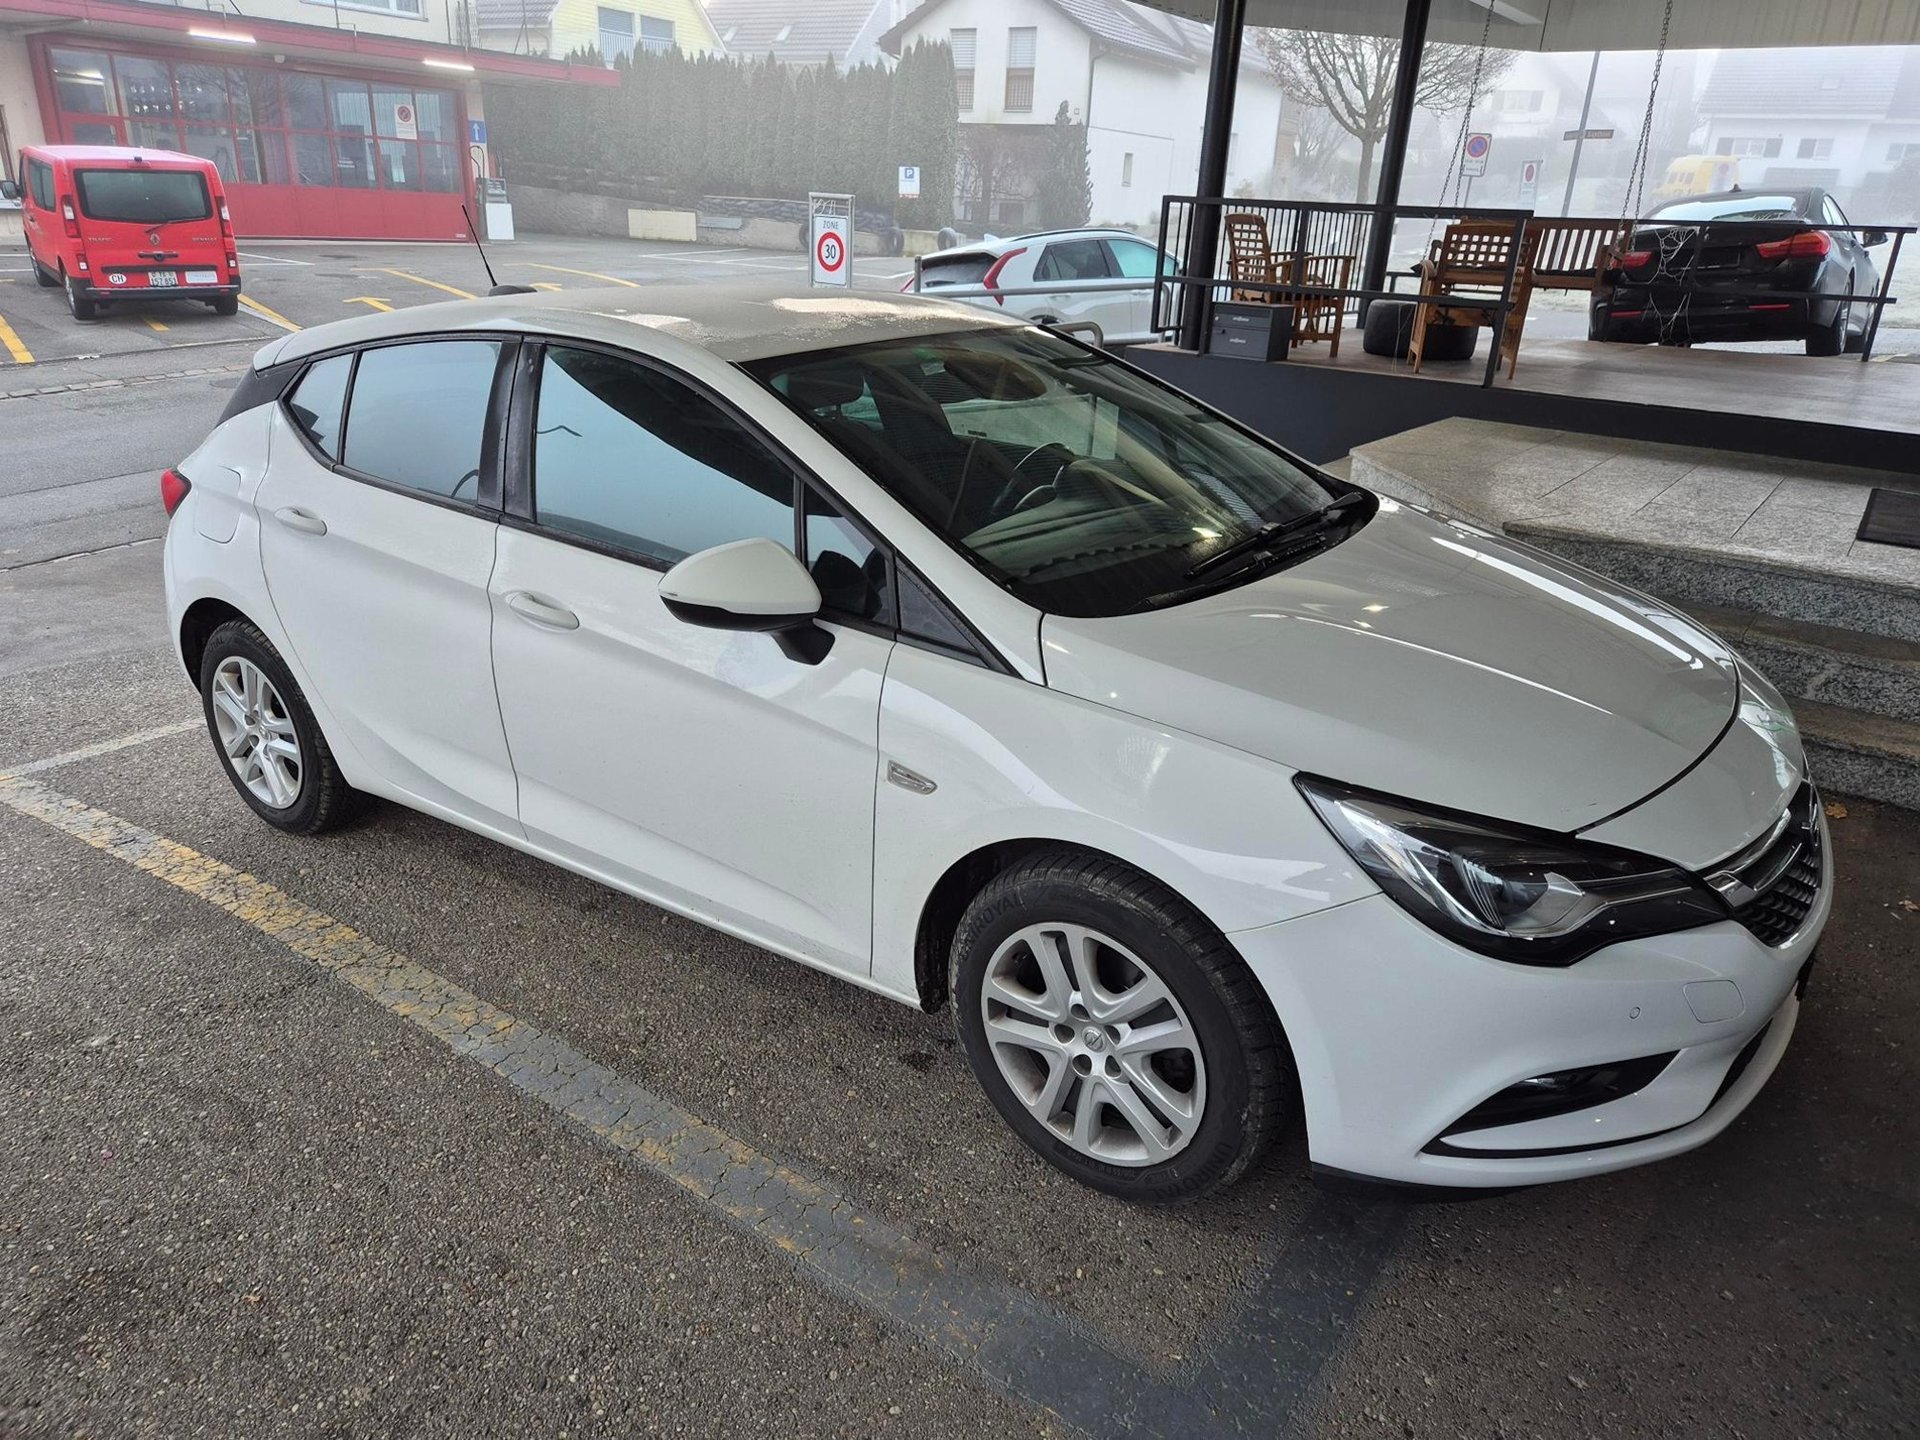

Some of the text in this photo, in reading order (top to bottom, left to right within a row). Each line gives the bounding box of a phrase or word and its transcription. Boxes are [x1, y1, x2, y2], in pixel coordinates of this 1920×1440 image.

[823, 220, 839, 229] ZONE
[825, 244, 837, 259] 30
[111, 274, 124, 283] CH
